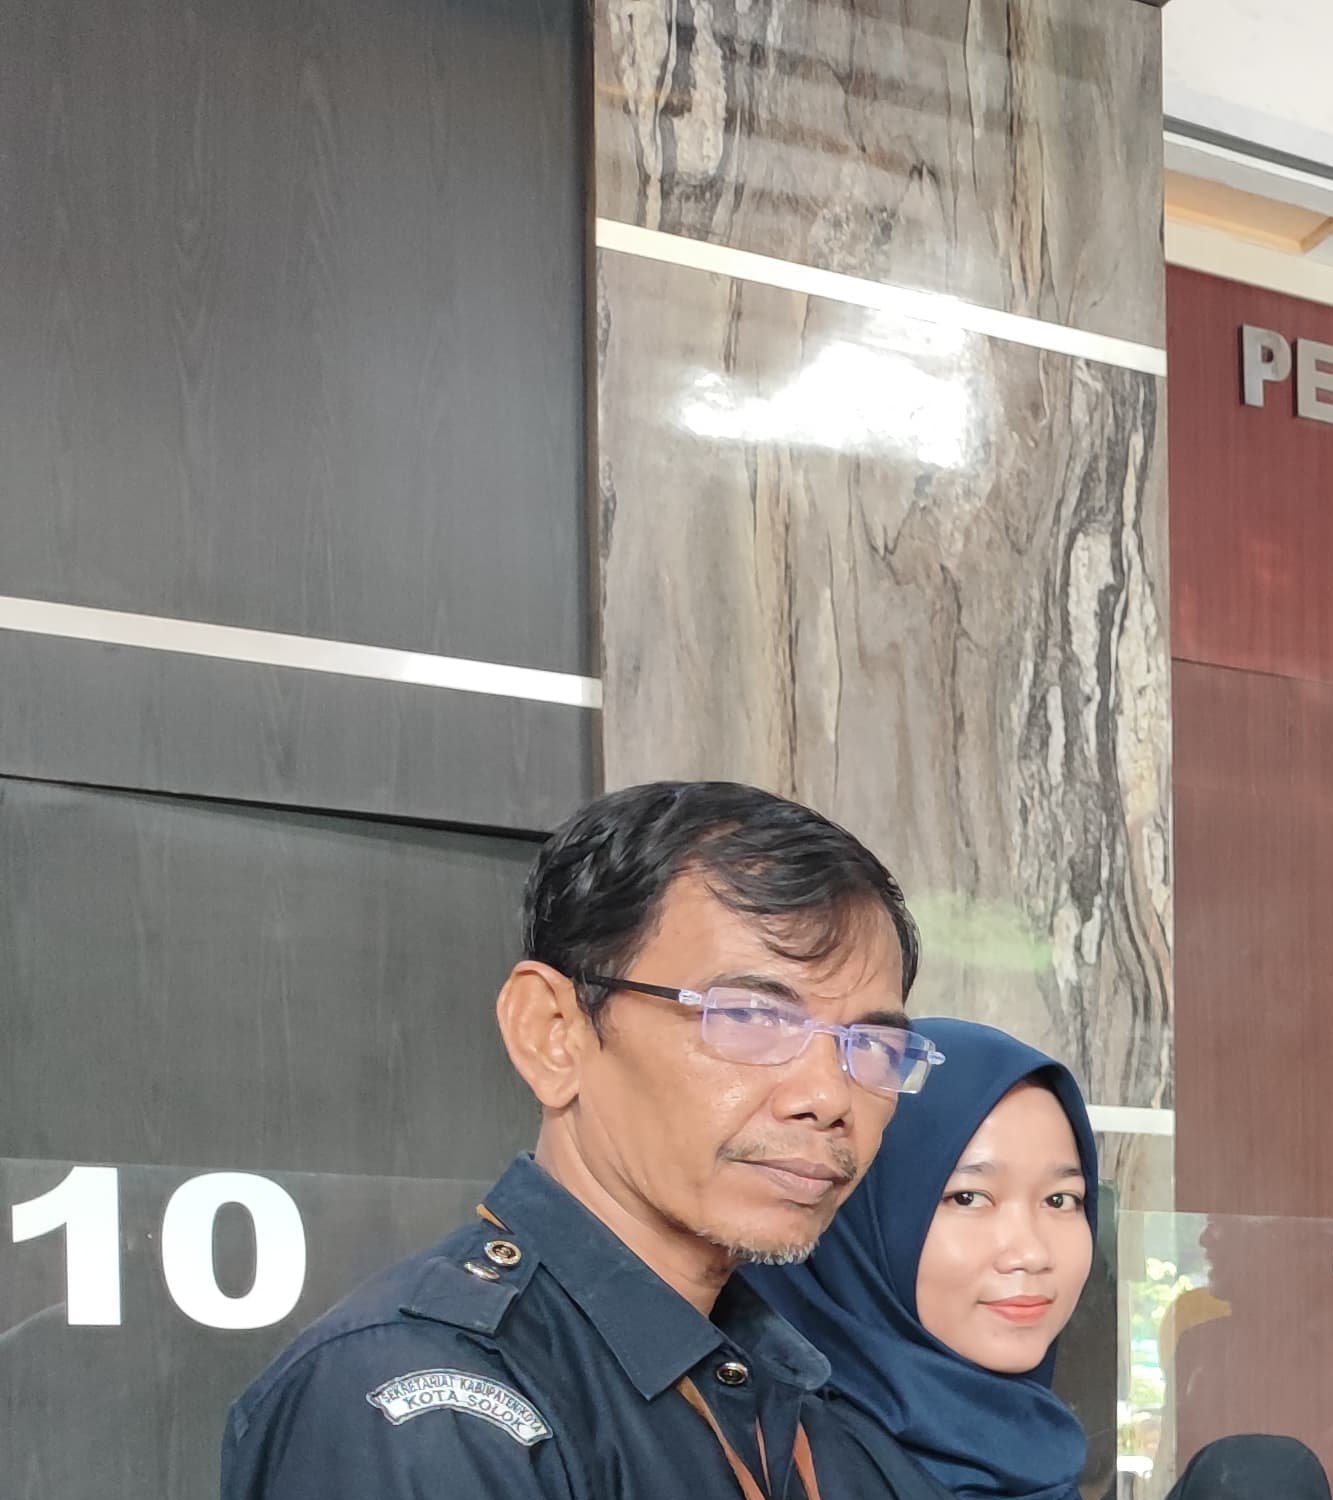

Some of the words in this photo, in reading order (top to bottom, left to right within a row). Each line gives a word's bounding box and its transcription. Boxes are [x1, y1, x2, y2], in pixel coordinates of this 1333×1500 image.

[12, 1166, 306, 1330] 10
[403, 1390, 460, 1410] KOTA
[467, 1395, 527, 1433] SOLOK
